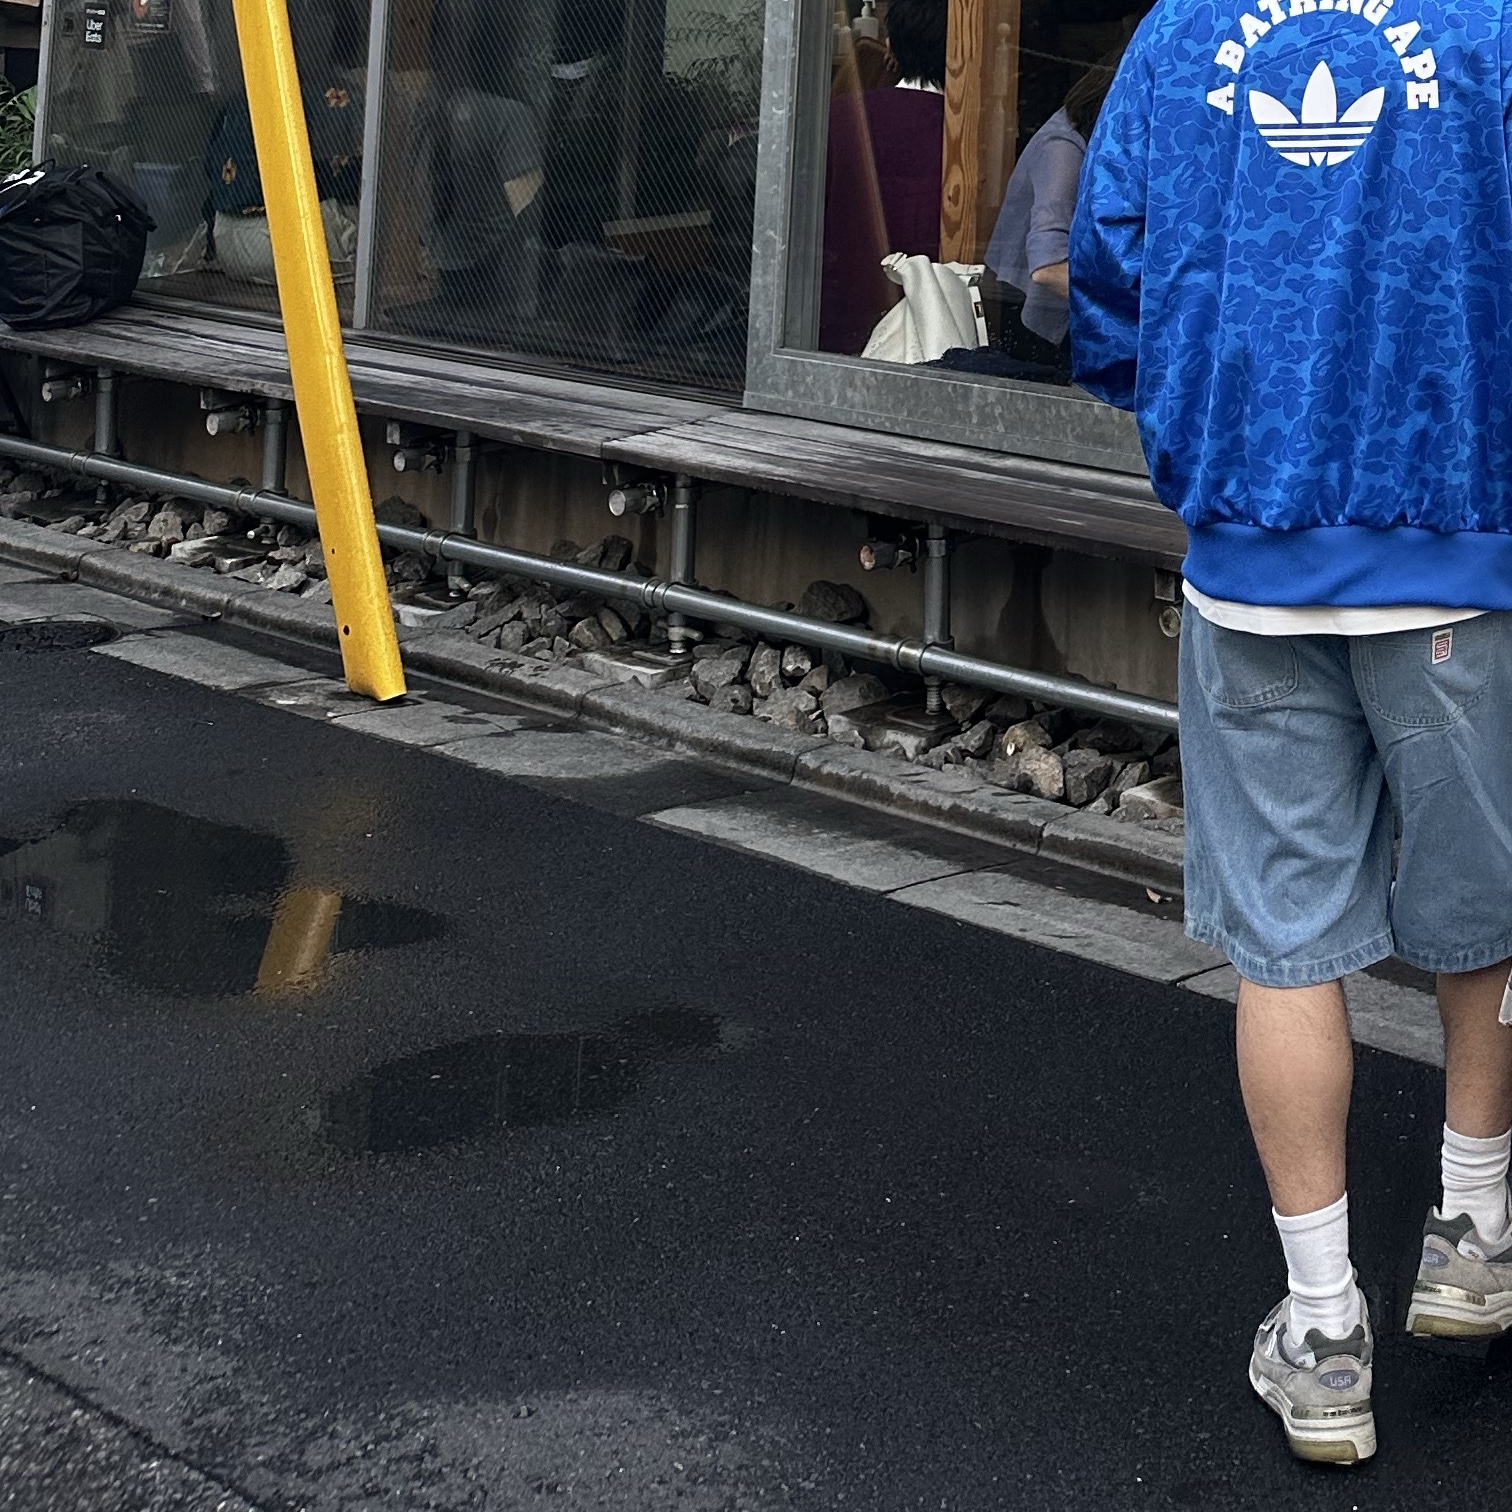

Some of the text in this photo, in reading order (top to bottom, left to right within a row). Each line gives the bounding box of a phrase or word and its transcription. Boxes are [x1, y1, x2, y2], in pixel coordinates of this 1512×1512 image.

[1206, 82, 1235, 115] A
[1383, 20, 1440, 110] APE
[1329, 1374, 1352, 1387] USA
